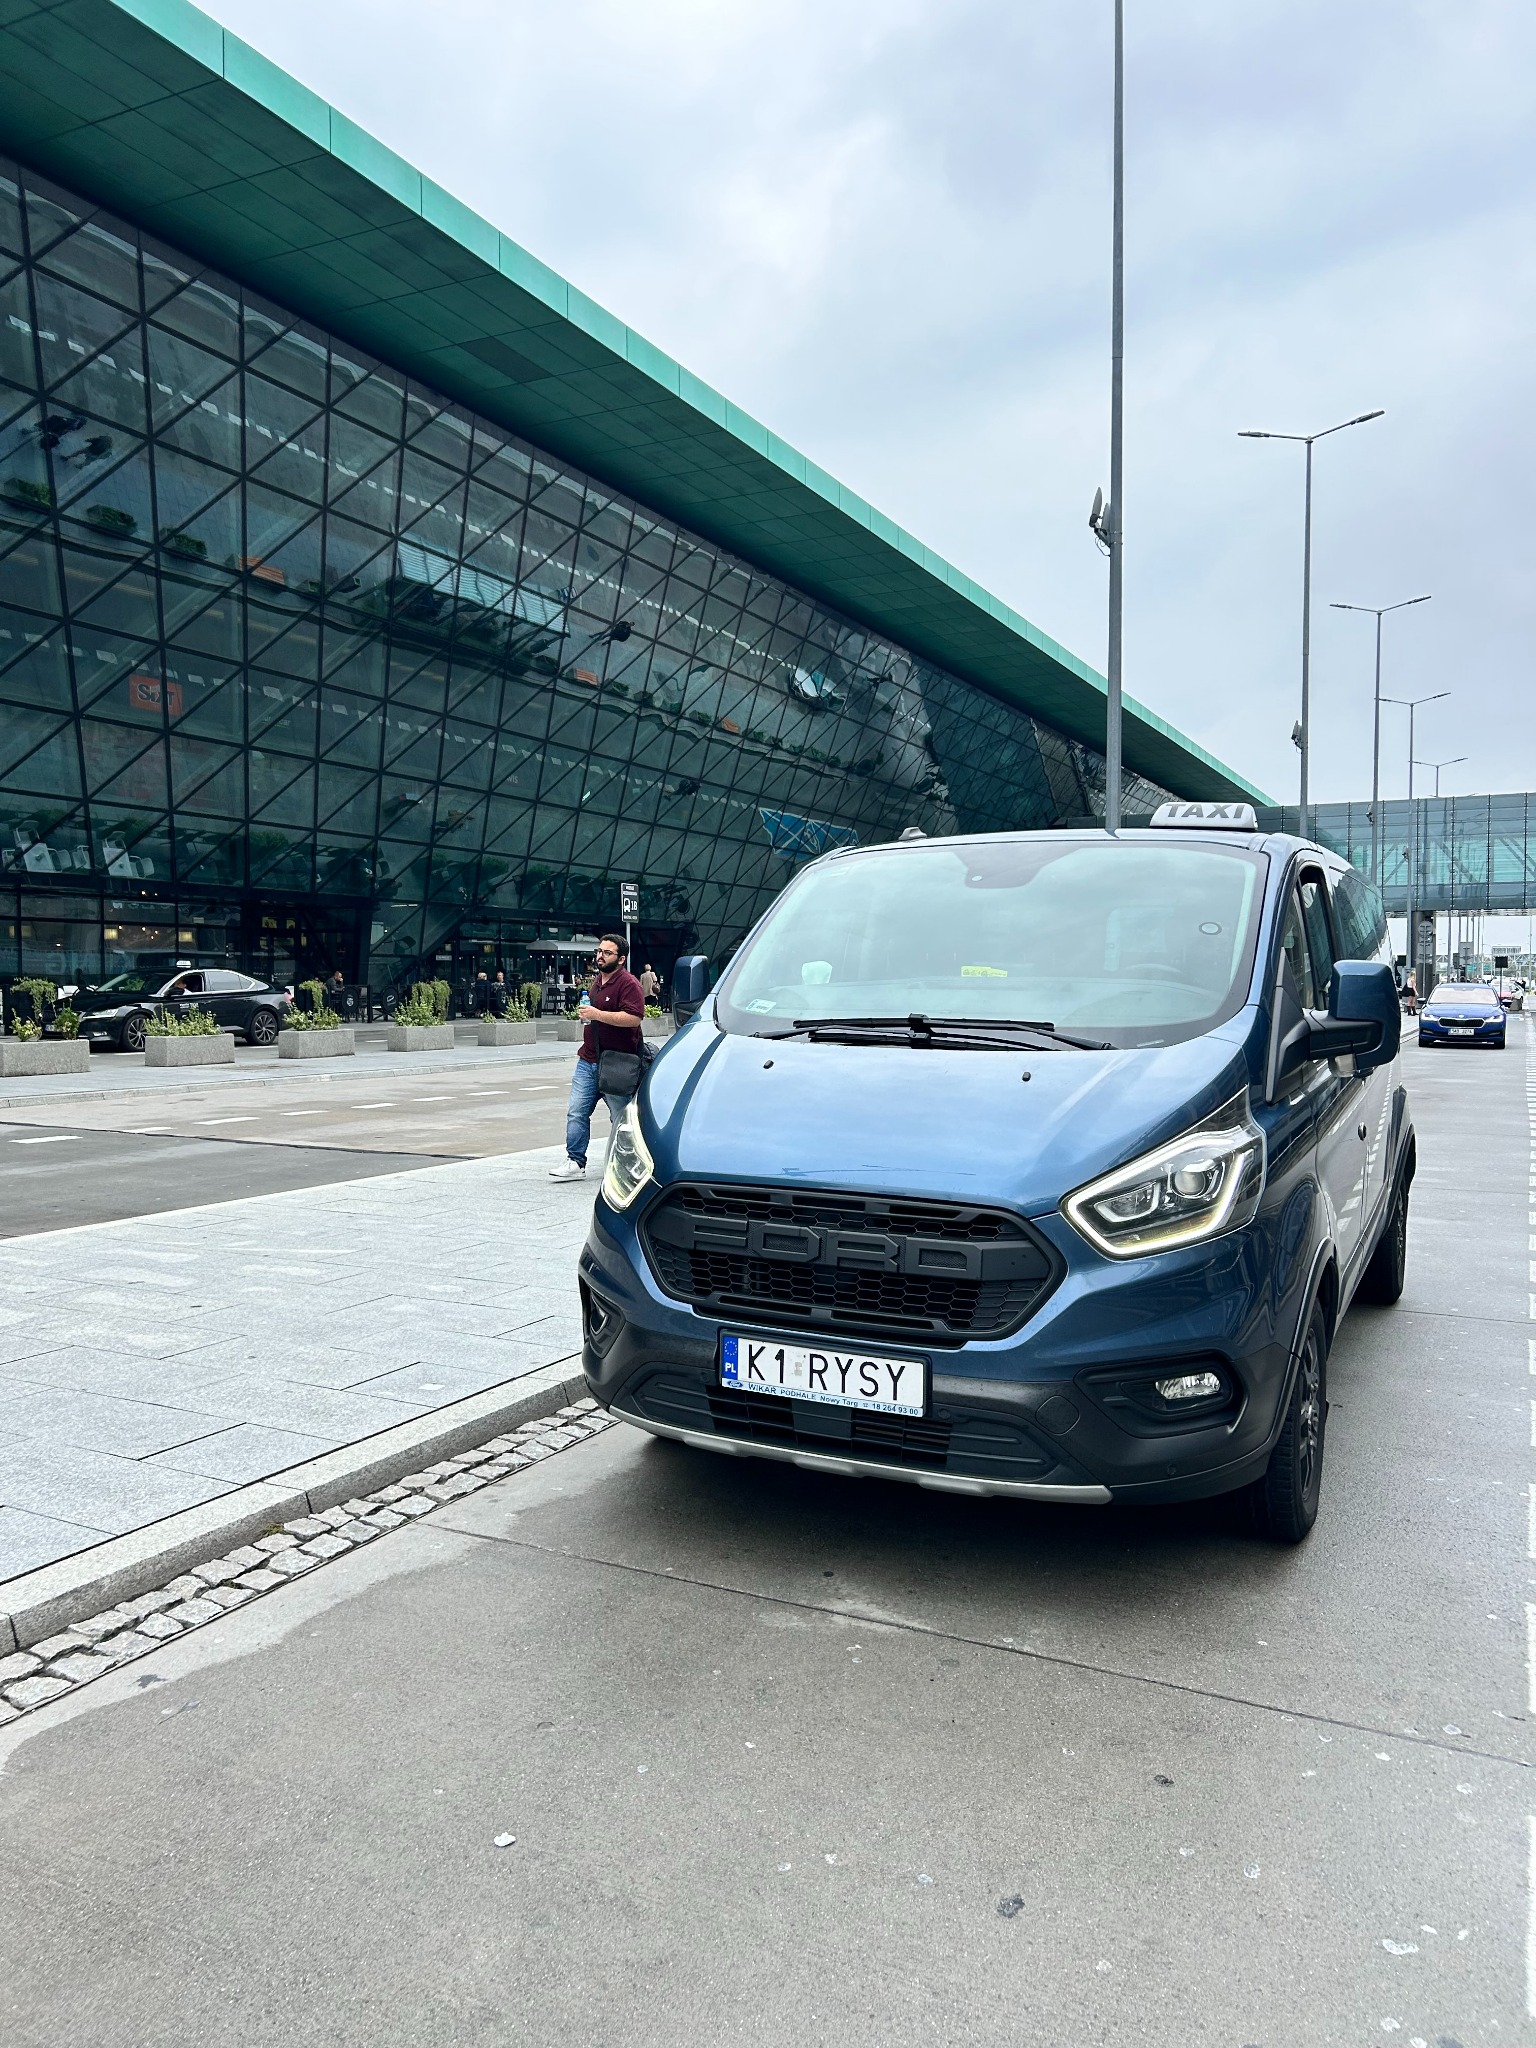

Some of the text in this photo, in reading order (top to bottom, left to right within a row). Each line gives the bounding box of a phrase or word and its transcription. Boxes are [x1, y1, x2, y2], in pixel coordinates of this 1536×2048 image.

[1165, 803, 1245, 818] TAXI
[692, 1215, 982, 1281] FORD
[724, 1362, 737, 1374] PL
[748, 1343, 906, 1401] K1 RYSY
[748, 1382, 777, 1395] WIKAR
[780, 1389, 817, 1400] PODHALE
[820, 1395, 840, 1405] Nowy
[842, 1398, 858, 1407] Targ
[872, 1402, 881, 1410] 18
